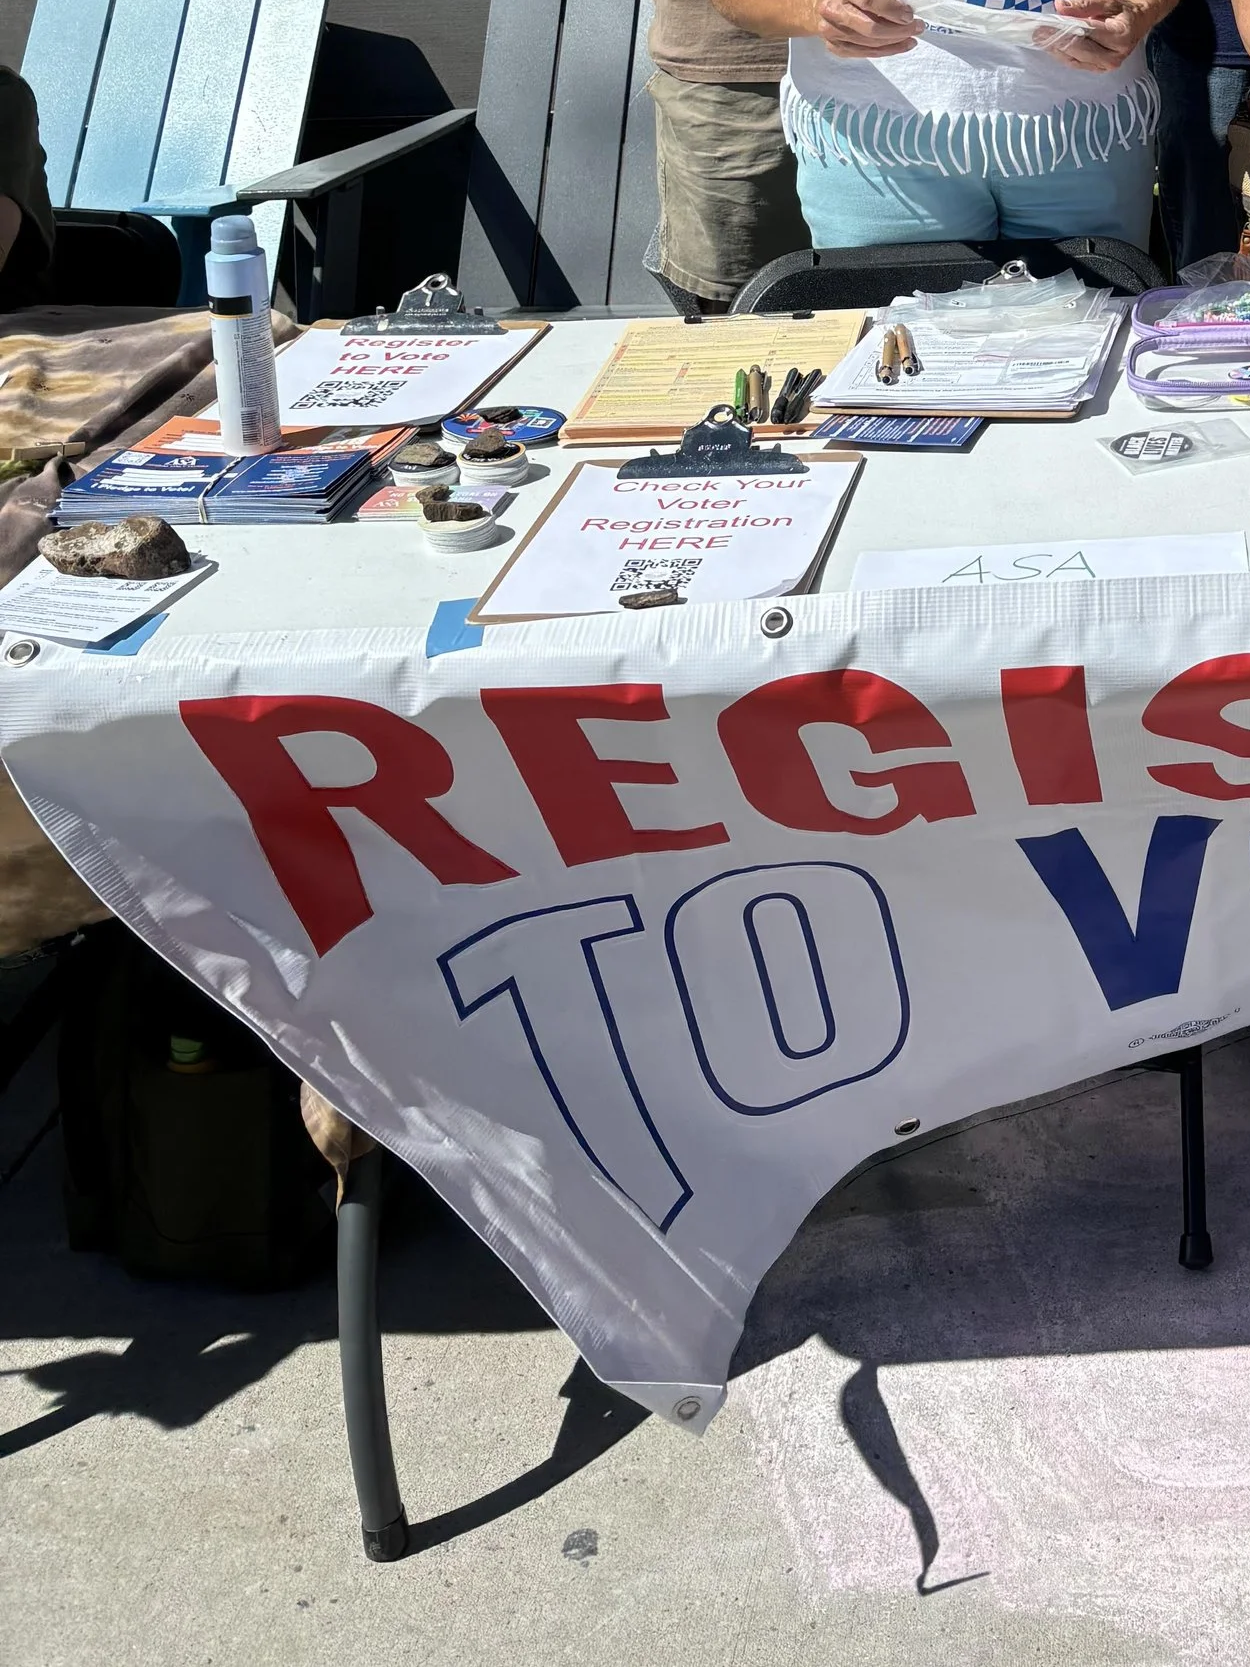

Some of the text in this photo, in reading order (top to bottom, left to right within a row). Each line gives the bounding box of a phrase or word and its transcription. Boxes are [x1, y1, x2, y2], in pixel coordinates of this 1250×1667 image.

[344, 338, 480, 349] Register
[339, 351, 451, 362] to Vote
[330, 365, 430, 375] HERE
[613, 477, 812, 493] Check Your
[657, 497, 747, 510] Voter
[580, 515, 794, 533] Registration
[618, 535, 733, 551] HERE
[436, 861, 912, 1233] TO
